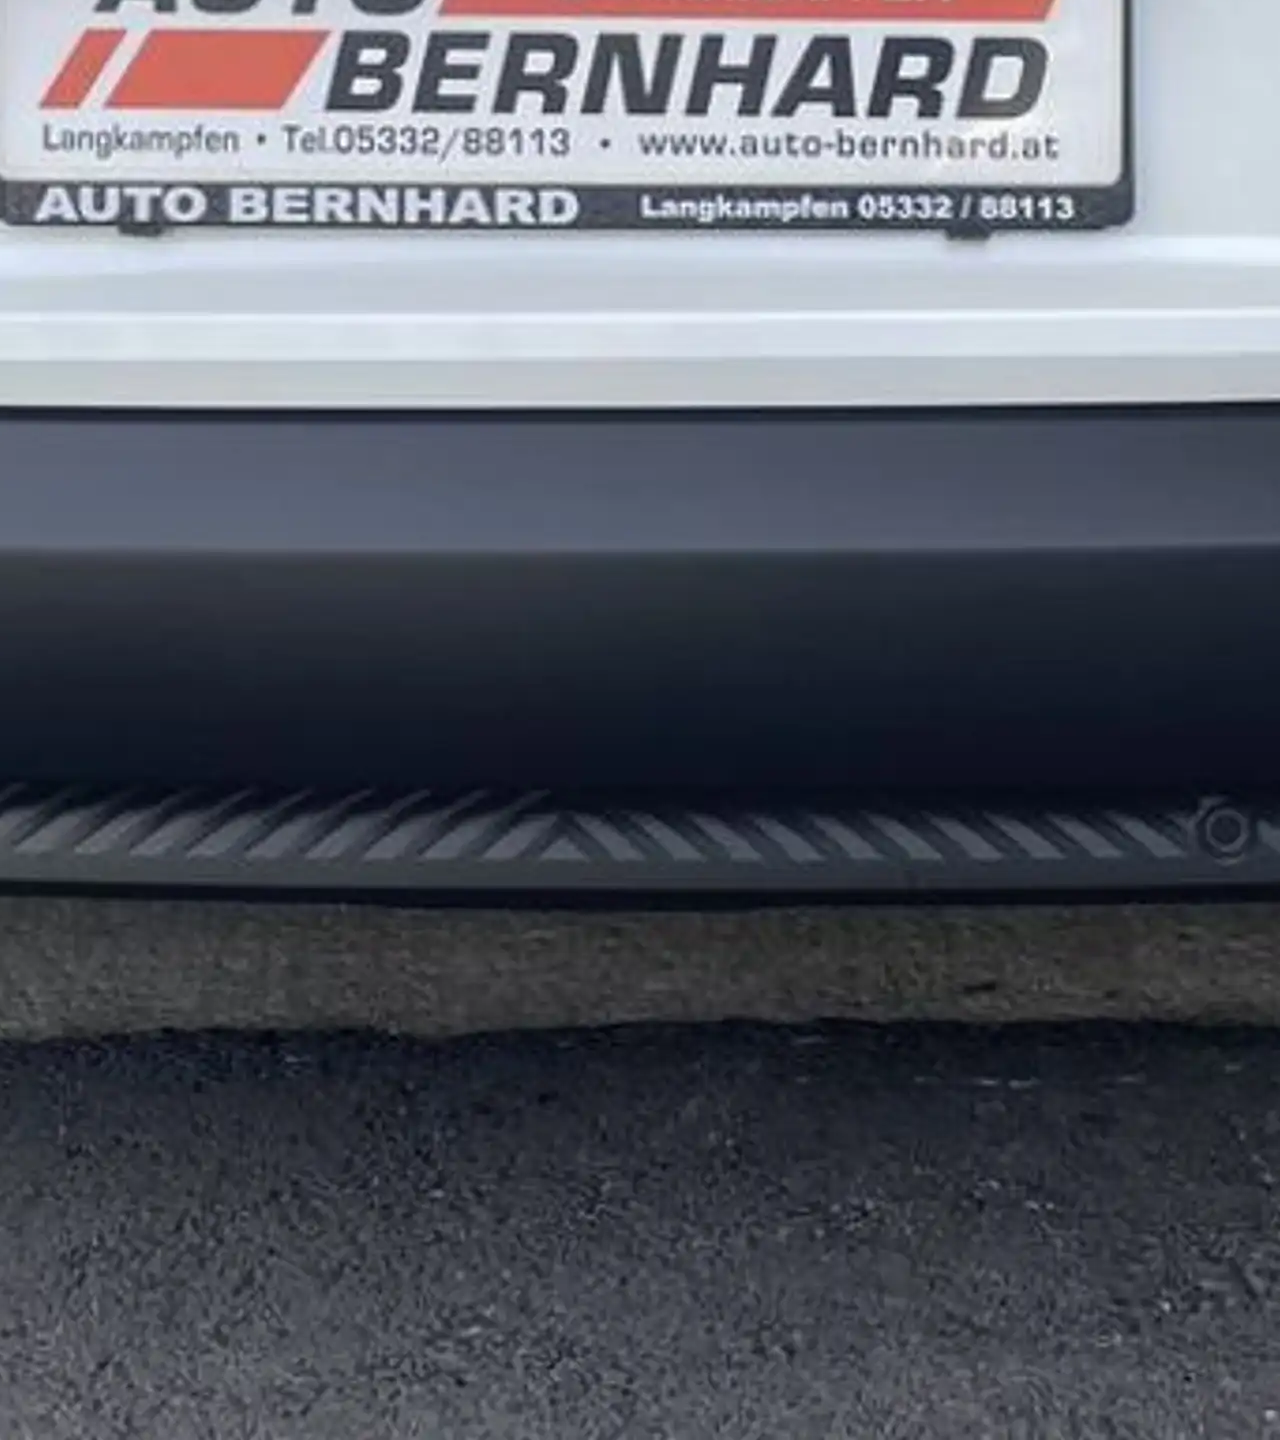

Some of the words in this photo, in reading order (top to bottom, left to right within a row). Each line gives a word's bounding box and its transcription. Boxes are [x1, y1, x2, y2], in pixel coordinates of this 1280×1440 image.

[325, 29, 1051, 120] BERNHARD
[43, 124, 240, 159] Langkampfen
[638, 128, 1060, 160] www.auto-bernhard.at
[34, 185, 208, 223] AUTO
[228, 186, 580, 225] BERNHARD
[640, 193, 849, 223] Langkampfen
[857, 194, 954, 220] 05332
[979, 195, 1075, 221] 88113
